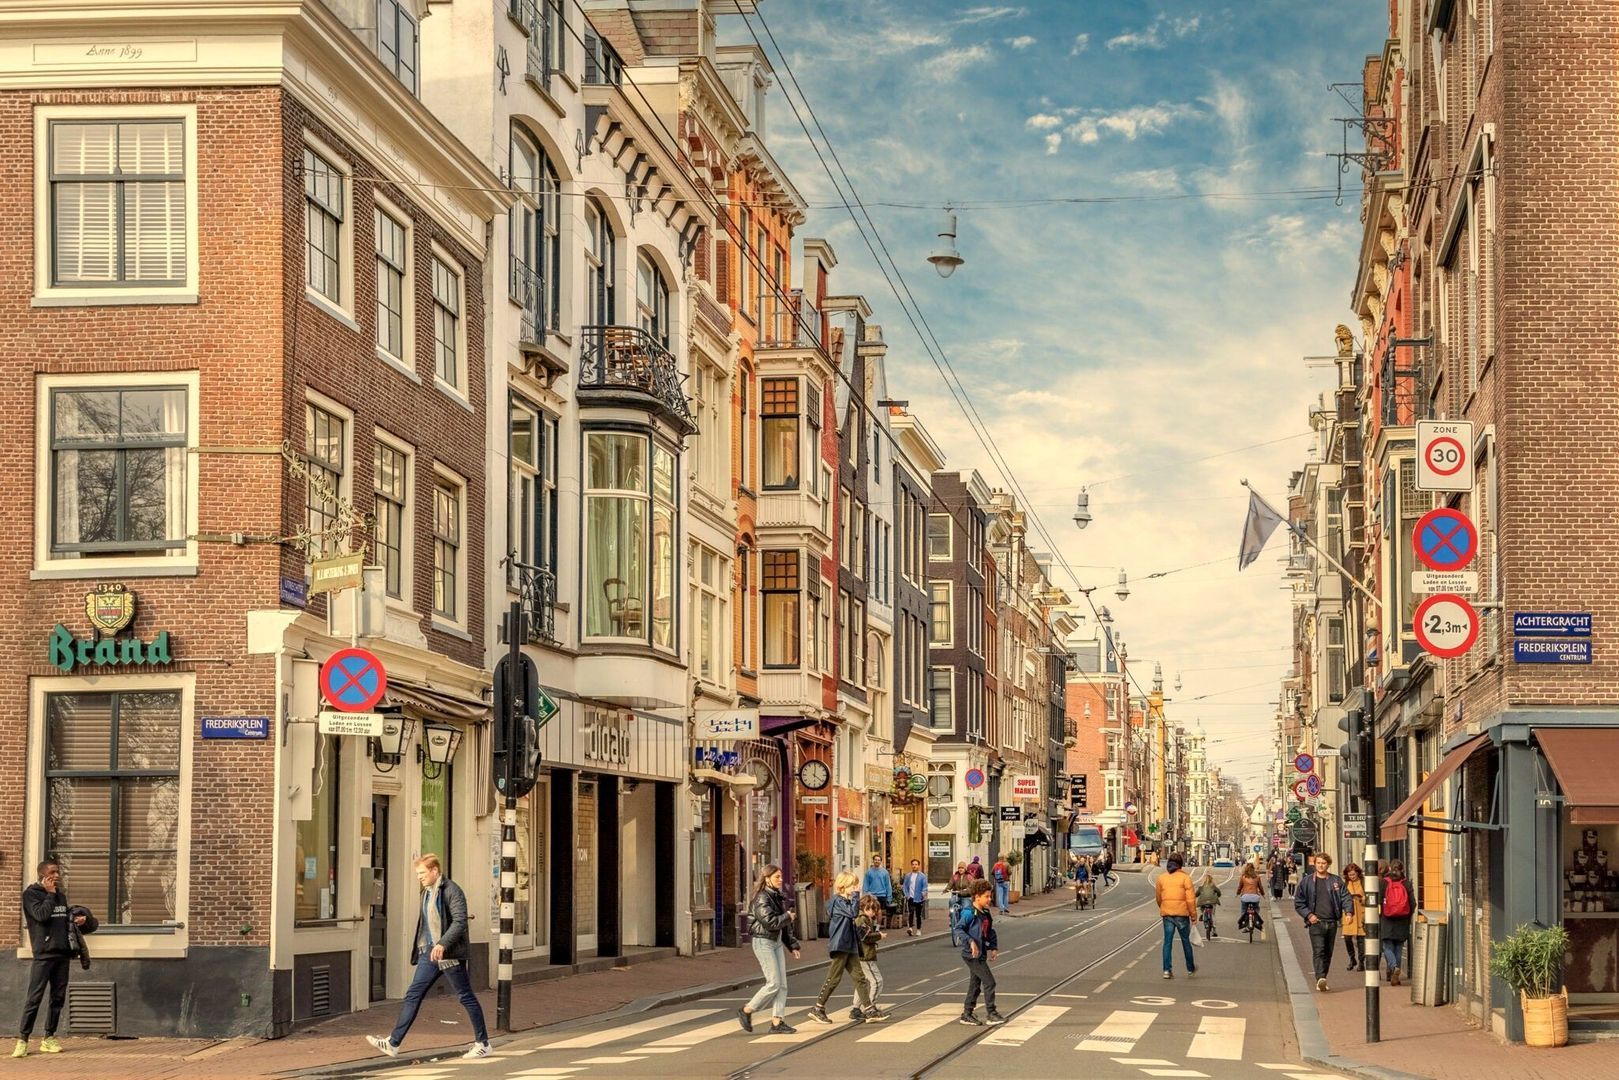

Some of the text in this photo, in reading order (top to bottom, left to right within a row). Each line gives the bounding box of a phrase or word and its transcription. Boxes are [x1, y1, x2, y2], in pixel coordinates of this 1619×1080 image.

[120, 44, 143, 59] 1899
[1433, 449, 1458, 463] 30
[98, 584, 122, 592] 1340
[1430, 614, 1461, 635] 2,3m
[1516, 616, 1589, 626] ACHTERGRACHT
[49, 622, 172, 672] Brand
[1518, 643, 1587, 653] FREDERIKSPLEIN
[206, 720, 262, 728] FREDERIKSPLEIN
[709, 725, 745, 733] Jack
[710, 718, 753, 730] Lucky
